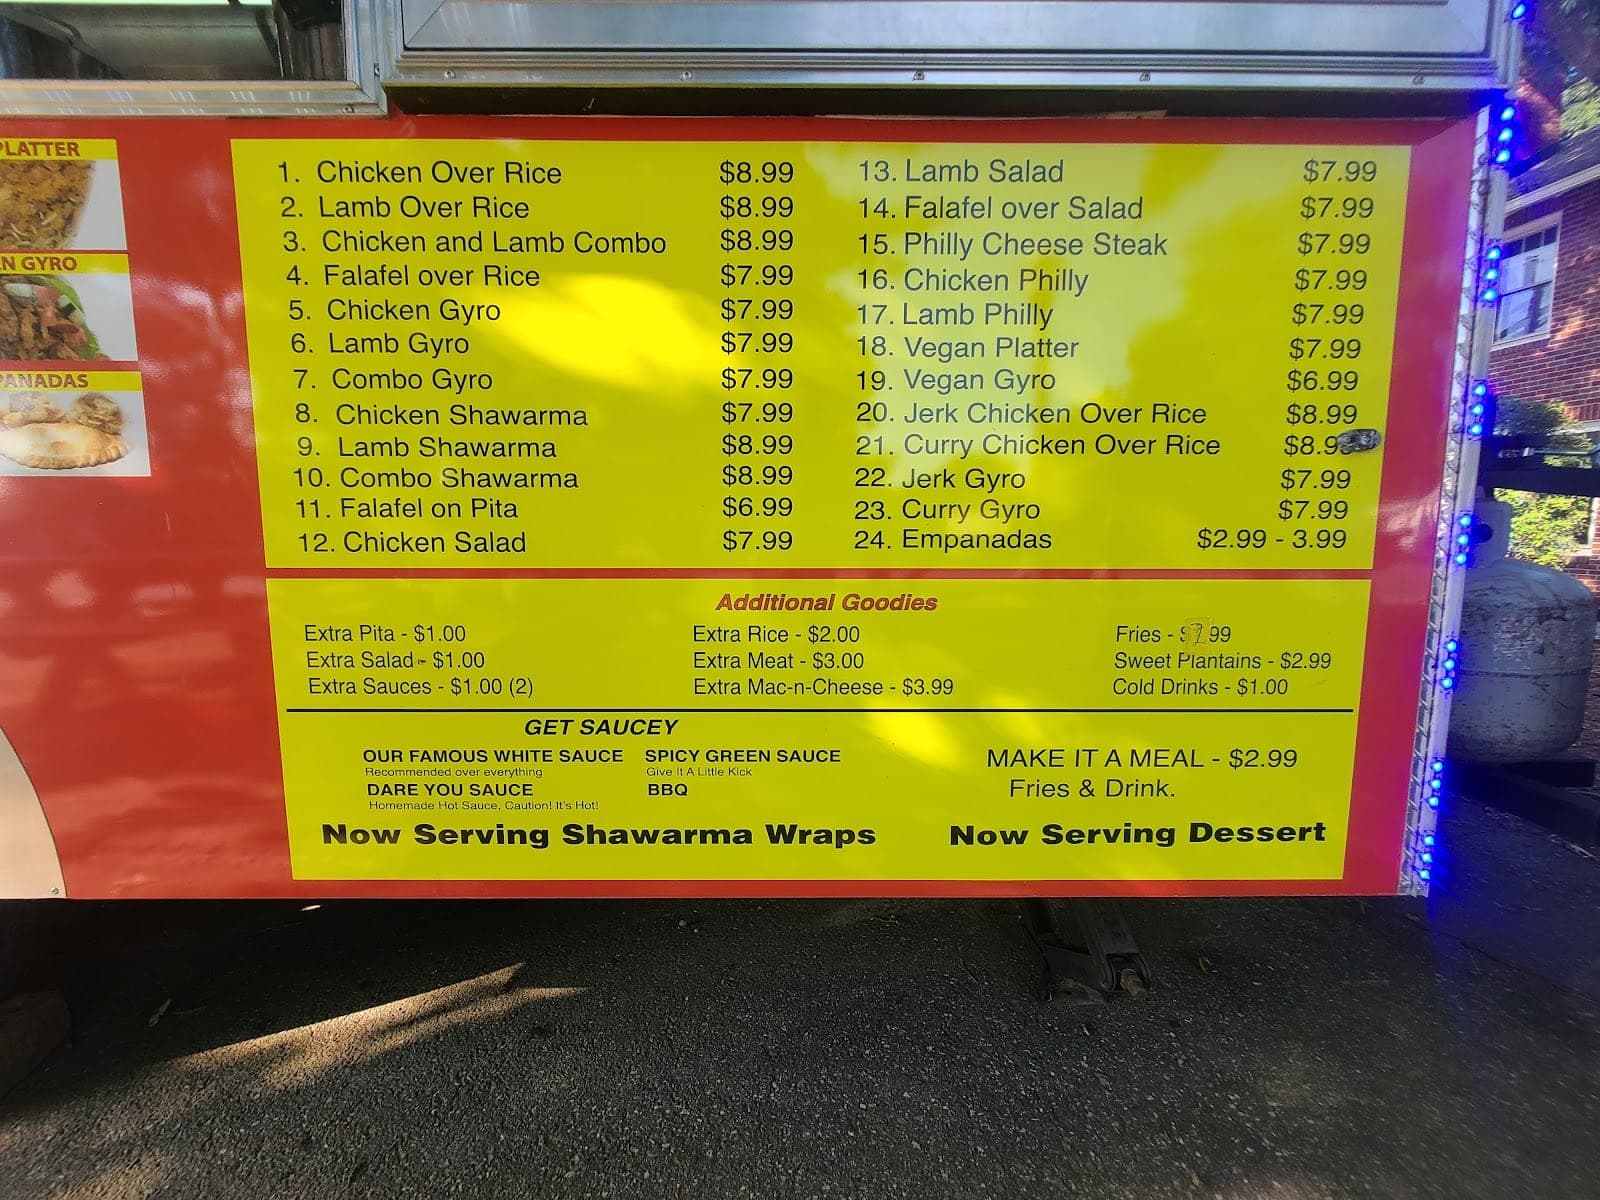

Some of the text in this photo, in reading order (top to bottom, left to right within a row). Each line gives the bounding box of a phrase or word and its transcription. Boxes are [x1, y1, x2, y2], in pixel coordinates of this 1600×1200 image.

[0, 141, 80, 156] LATTER
[317, 159, 794, 187] Chicken Over Rice $8.99
[906, 158, 1377, 185] Lamb Salad $7.99
[319, 193, 794, 221] Lamb Over Rice $8.99
[905, 195, 1374, 221] Falafel over Salad $7.99
[322, 227, 794, 254] Chicken and Lamb Combo $8.99
[904, 231, 1371, 262] Philly Cheese Steak $7.99
[21, 256, 78, 271] GYRO
[324, 262, 794, 289] Falafel over Rice $7.99
[904, 267, 1368, 298] Chicken Philly $7.99
[327, 296, 794, 326] Chicken Gyro $7.99
[903, 301, 1365, 331] Lamb Philly $7.99
[903, 336, 1362, 364] Vegan Platter $7.99
[0, 373, 89, 388] ANADAS
[332, 366, 793, 395] Combo Gyro $7.99
[903, 367, 1359, 396] Vegan Gyro $6.99
[335, 400, 793, 426] Chicken Shawarma $7.99
[903, 402, 1358, 427] Jerk Chicken Over Rice $8.99
[338, 432, 793, 458] Lamb Shawarma $8.99
[904, 433, 974, 460] Curry
[982, 433, 1085, 455] Chicken
[1094, 433, 1157, 455] Over
[1165, 434, 1221, 455] Rice
[901, 467, 1351, 494] Jerk Gyro $7.99
[340, 494, 793, 520] Falafel on Pita $6.99
[902, 498, 1349, 525] Curry Gyro $7.99
[343, 528, 793, 553] Chicken Salad $7.99
[902, 527, 1347, 554] Empanadas $2.99 3.99
[714, 592, 939, 612] Additional Goodies
[304, 623, 466, 645] Extra Pita $1.00
[693, 623, 860, 646] Extra Rice $2.00
[1116, 625, 1161, 643] Fries
[306, 650, 485, 670] Extra Salad $1.00
[693, 650, 864, 672] Extra Meat $3.00
[1114, 651, 1332, 671] Sweet Plantains $2.99
[308, 676, 533, 699] Extra Sauces $1.00 (2)
[694, 677, 954, 698] Extra Mac-n-Cheese $3.99
[1112, 677, 1288, 697] Cold Drinks $1.00
[524, 718, 680, 736] GET SAUCEY
[362, 749, 624, 764] OUR FAMOUS WHITE SAUCE
[644, 749, 841, 763] SPICY GREEN SAUCE
[987, 747, 1298, 771] MAKE IT A MEAL $2.99
[365, 767, 543, 779] Recommended over everything
[646, 766, 752, 777] Give It A Little Kick
[367, 783, 534, 797] DARE YOU SAUCE
[647, 783, 688, 797] BBQ
[1010, 778, 1175, 798] Fries & Drink.
[369, 800, 599, 811] Homemade Hot Sauce, Caution! It's Hot!
[322, 823, 876, 850] Now Serving Shawarma Wraps
[950, 822, 1327, 848] Now Serving Dessert
